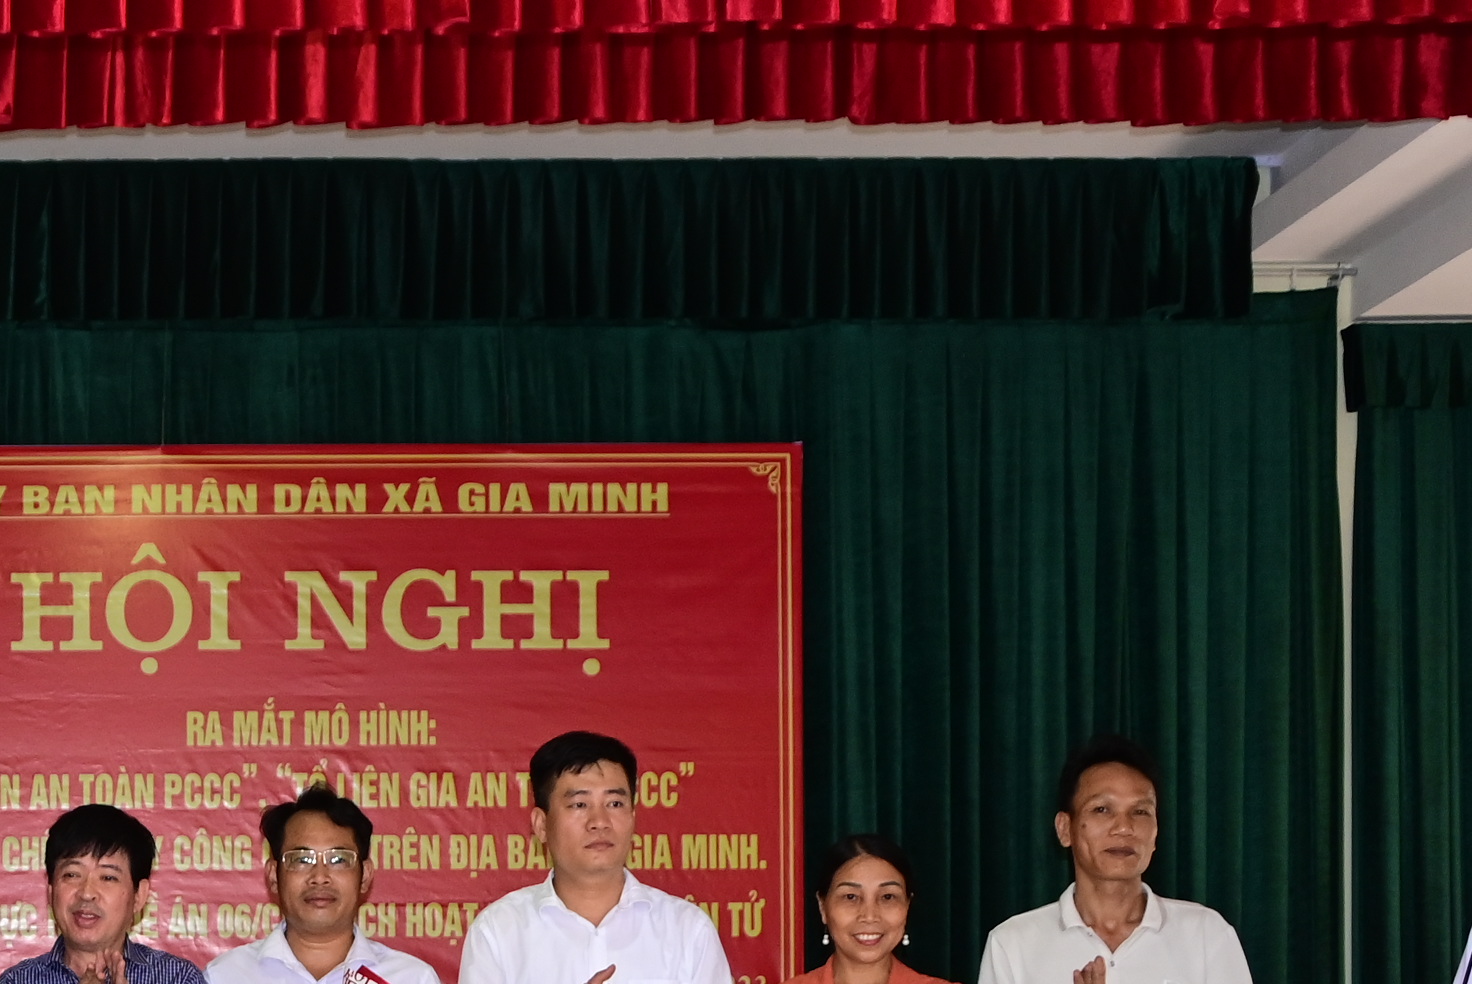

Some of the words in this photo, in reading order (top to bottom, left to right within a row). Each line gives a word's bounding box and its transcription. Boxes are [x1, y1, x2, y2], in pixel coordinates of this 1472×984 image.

[22, 485, 115, 514] BAN
[131, 477, 258, 514] NHÂN
[274, 477, 366, 513] DÂN
[381, 476, 443, 513] XÃ
[458, 482, 533, 513] GIA
[549, 482, 669, 513] MINH
[10, 542, 241, 675] HỘI
[284, 568, 611, 676] NGHỊ
[186, 711, 224, 746] RA
[233, 697, 296, 746] MẮT
[304, 702, 350, 746] MÔ
[359, 702, 437, 746] HÌNH:
[28, 773, 70, 810] AN
[78, 765, 154, 809] TOÀN
[409, 772, 458, 808] GIA
[466, 772, 507, 808] AN
[173, 827, 253, 871] CÔNG
[370, 826, 440, 870] TRÊN
[449, 834, 499, 878] ĐỊA
[626, 833, 673, 870] GIA
[681, 834, 767, 870] MINH.
[167, 896, 209, 939] ÁN
[406, 902, 479, 946] HOẠT
[727, 890, 766, 938] TỬ
